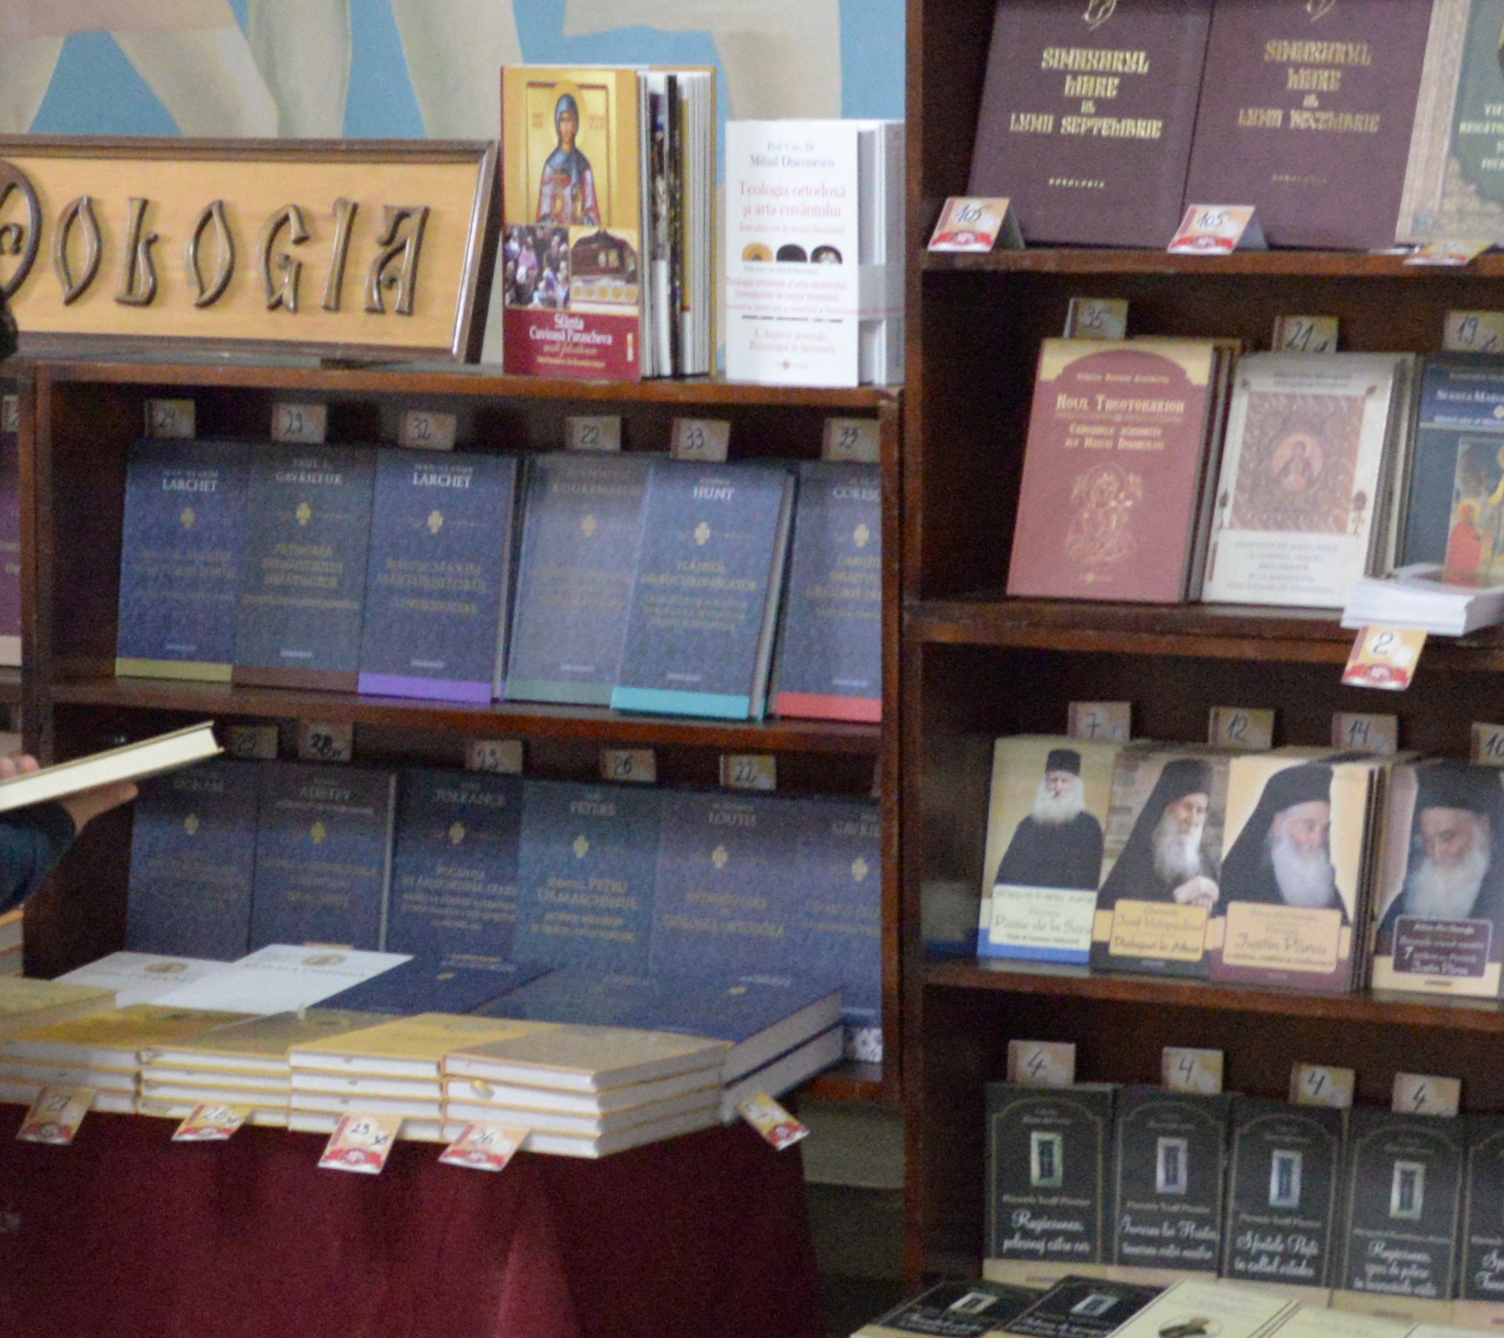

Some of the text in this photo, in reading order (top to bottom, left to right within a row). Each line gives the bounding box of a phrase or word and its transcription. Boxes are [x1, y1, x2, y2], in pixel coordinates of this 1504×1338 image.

[162, 477, 218, 493] LARCHET
[413, 472, 471, 489] LARCHET
[692, 485, 735, 501] HUNT
